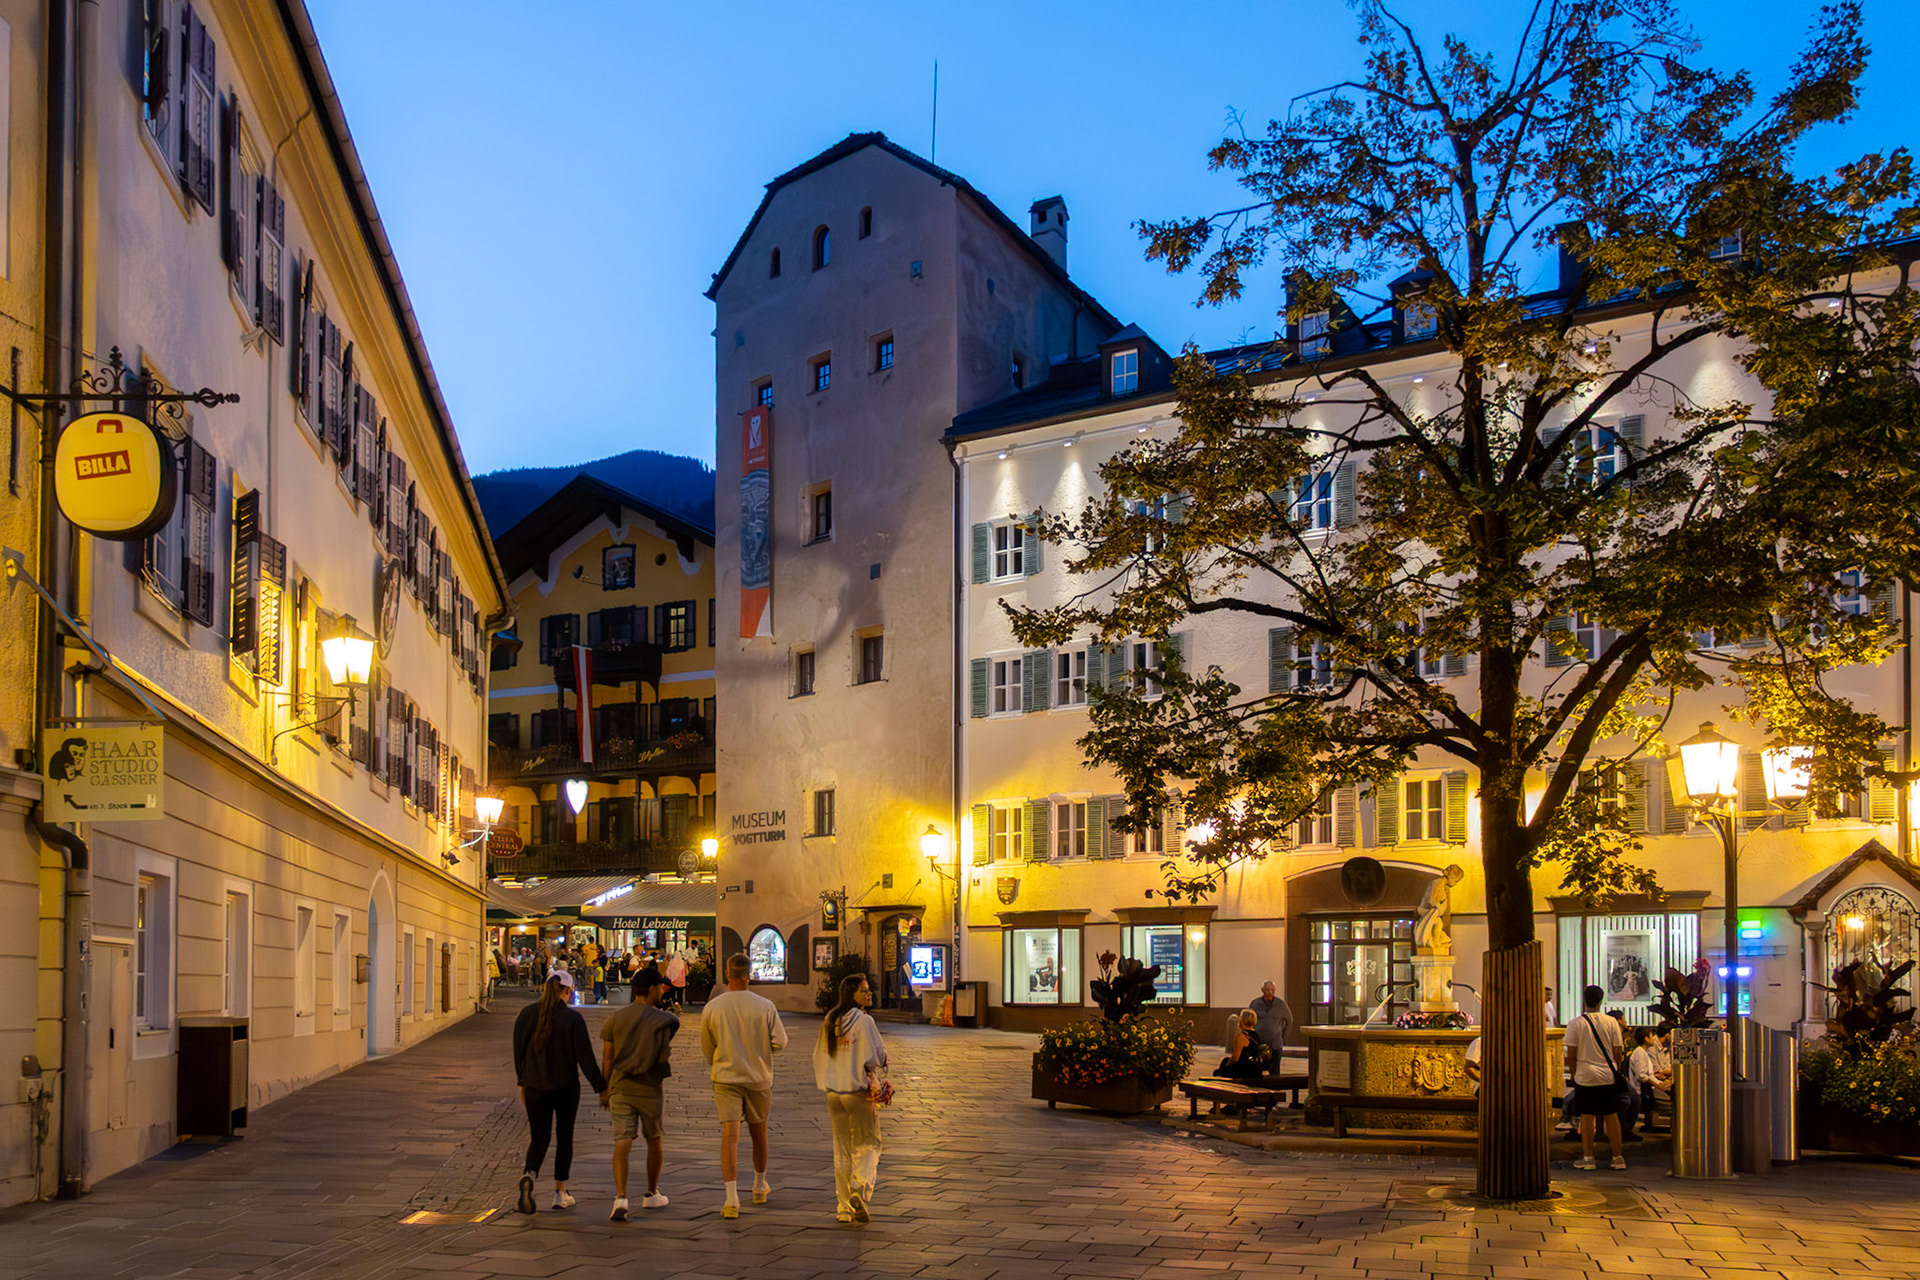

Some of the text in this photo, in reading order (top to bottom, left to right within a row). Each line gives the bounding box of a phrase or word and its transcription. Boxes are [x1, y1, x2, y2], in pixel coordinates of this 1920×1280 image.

[77, 455, 128, 476] BILLA
[90, 741, 157, 758] HAAR
[90, 759, 159, 774] STUDIO
[90, 774, 158, 786] GASSNER
[732, 810, 786, 829] MUSEUM
[733, 829, 786, 845] VOGTTURM
[613, 918, 690, 929] Hotel Lebzelter
